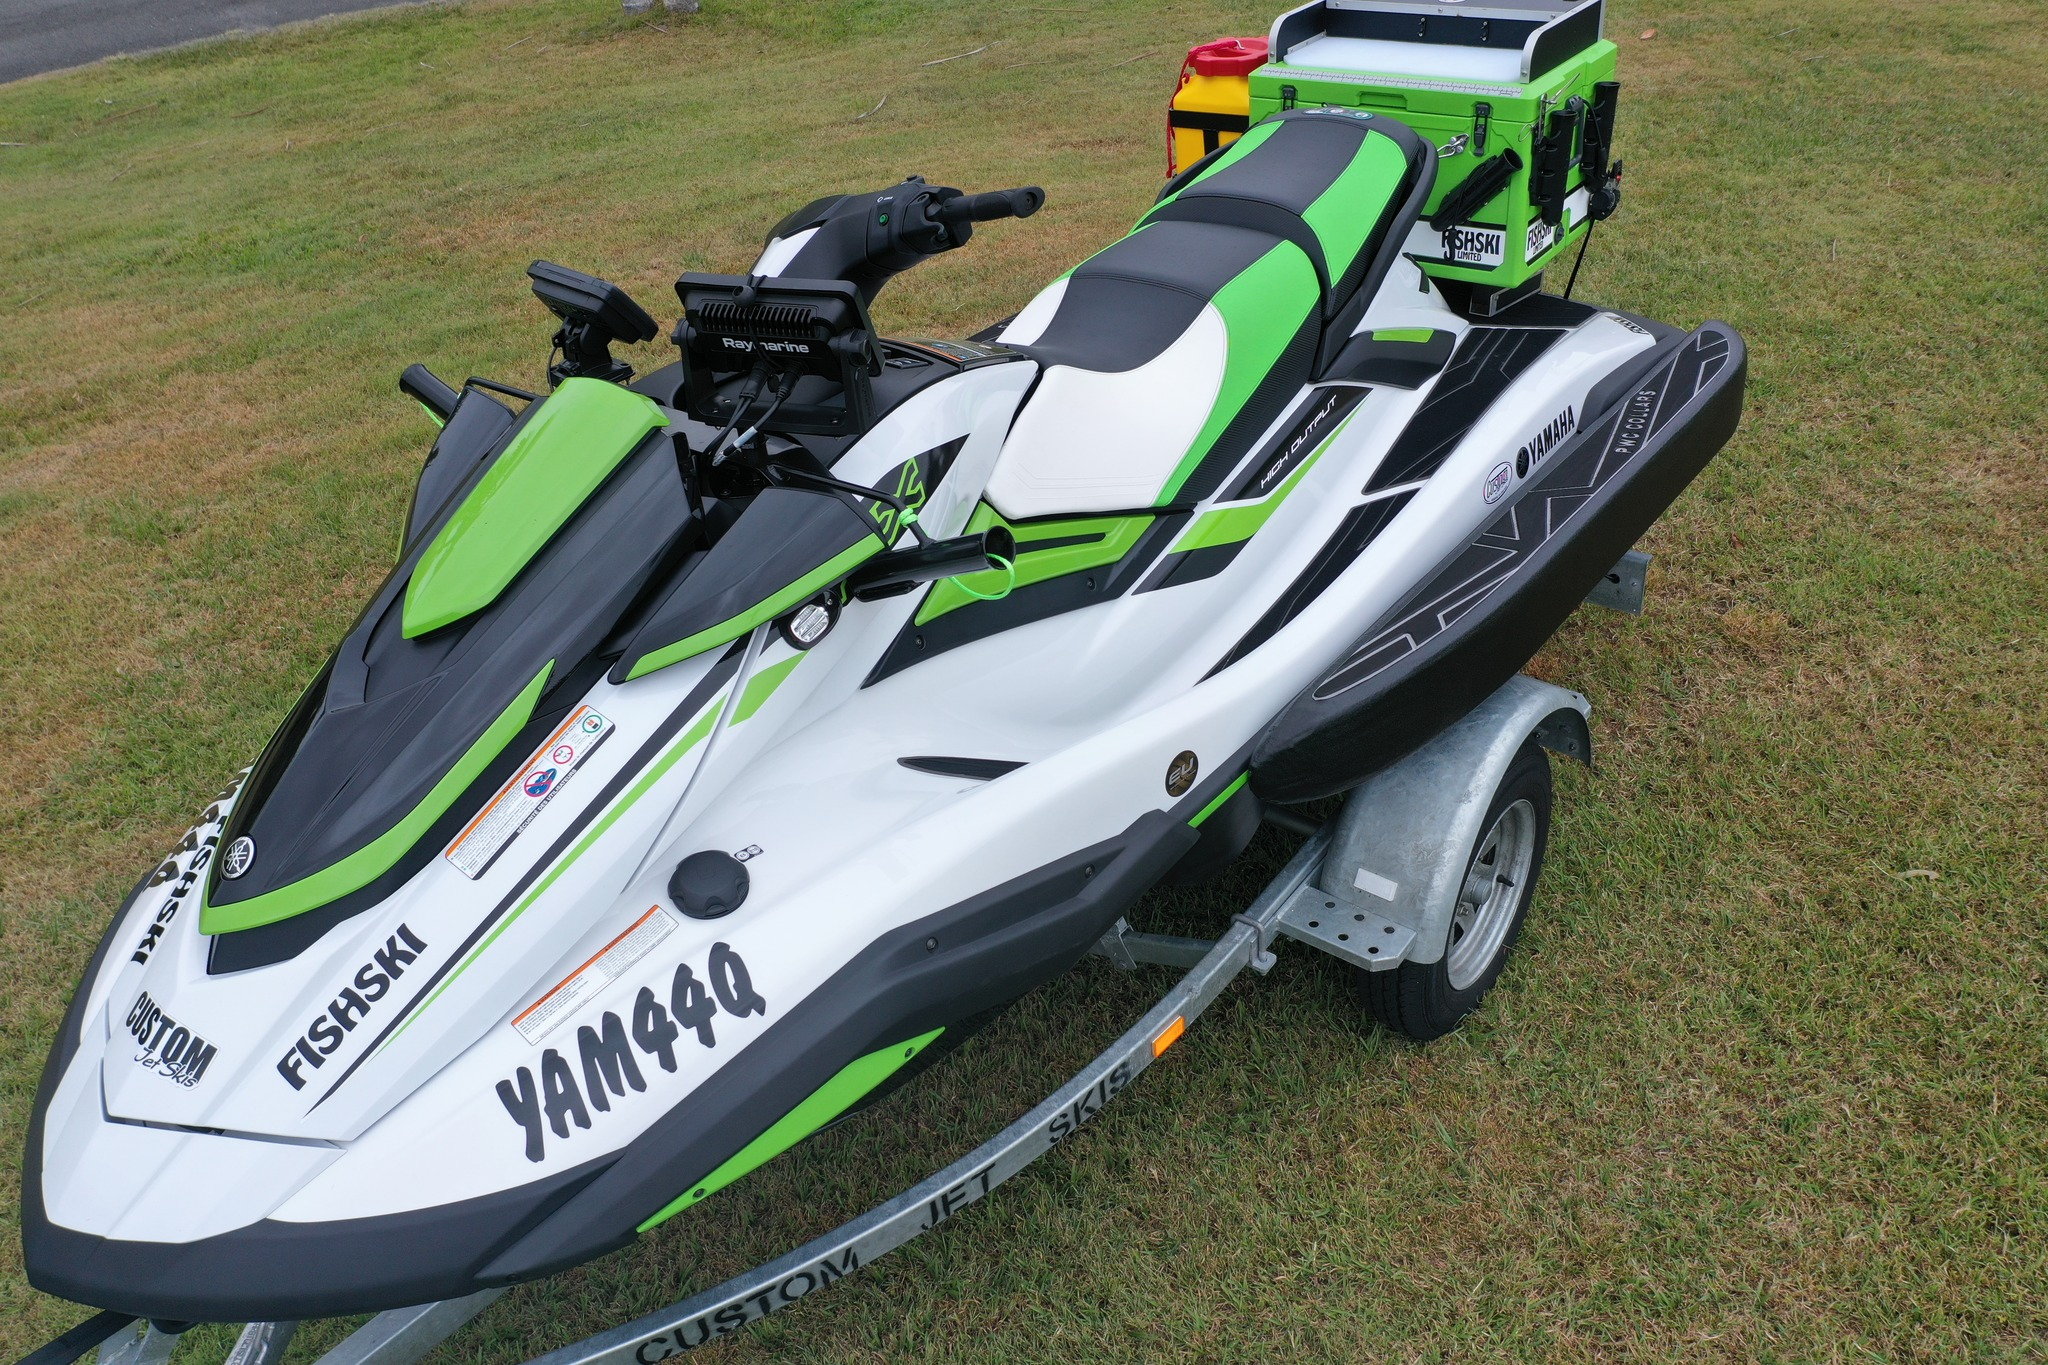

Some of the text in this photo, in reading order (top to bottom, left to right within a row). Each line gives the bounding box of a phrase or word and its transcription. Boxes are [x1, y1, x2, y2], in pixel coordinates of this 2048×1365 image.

[1457, 250, 1482, 262] LIMITED
[721, 337, 810, 353] Raymarine
[1260, 394, 1337, 489] HIGH OUTPUT
[1528, 404, 1575, 466] YAMAHA
[1615, 390, 1656, 454] PWC COLLARS
[515, 808, 540, 835] SÉCURITÉ
[536, 798, 549, 812] DES
[546, 767, 578, 802] UTILISATEURS
[125, 991, 218, 1082] CUSTOM
[276, 922, 428, 1092] FISHSKI
[134, 1047, 200, 1088] Jet Skis
[495, 941, 766, 1163] YAM44Q
[635, 1061, 1131, 1365] CUSTOM JET SKIS
